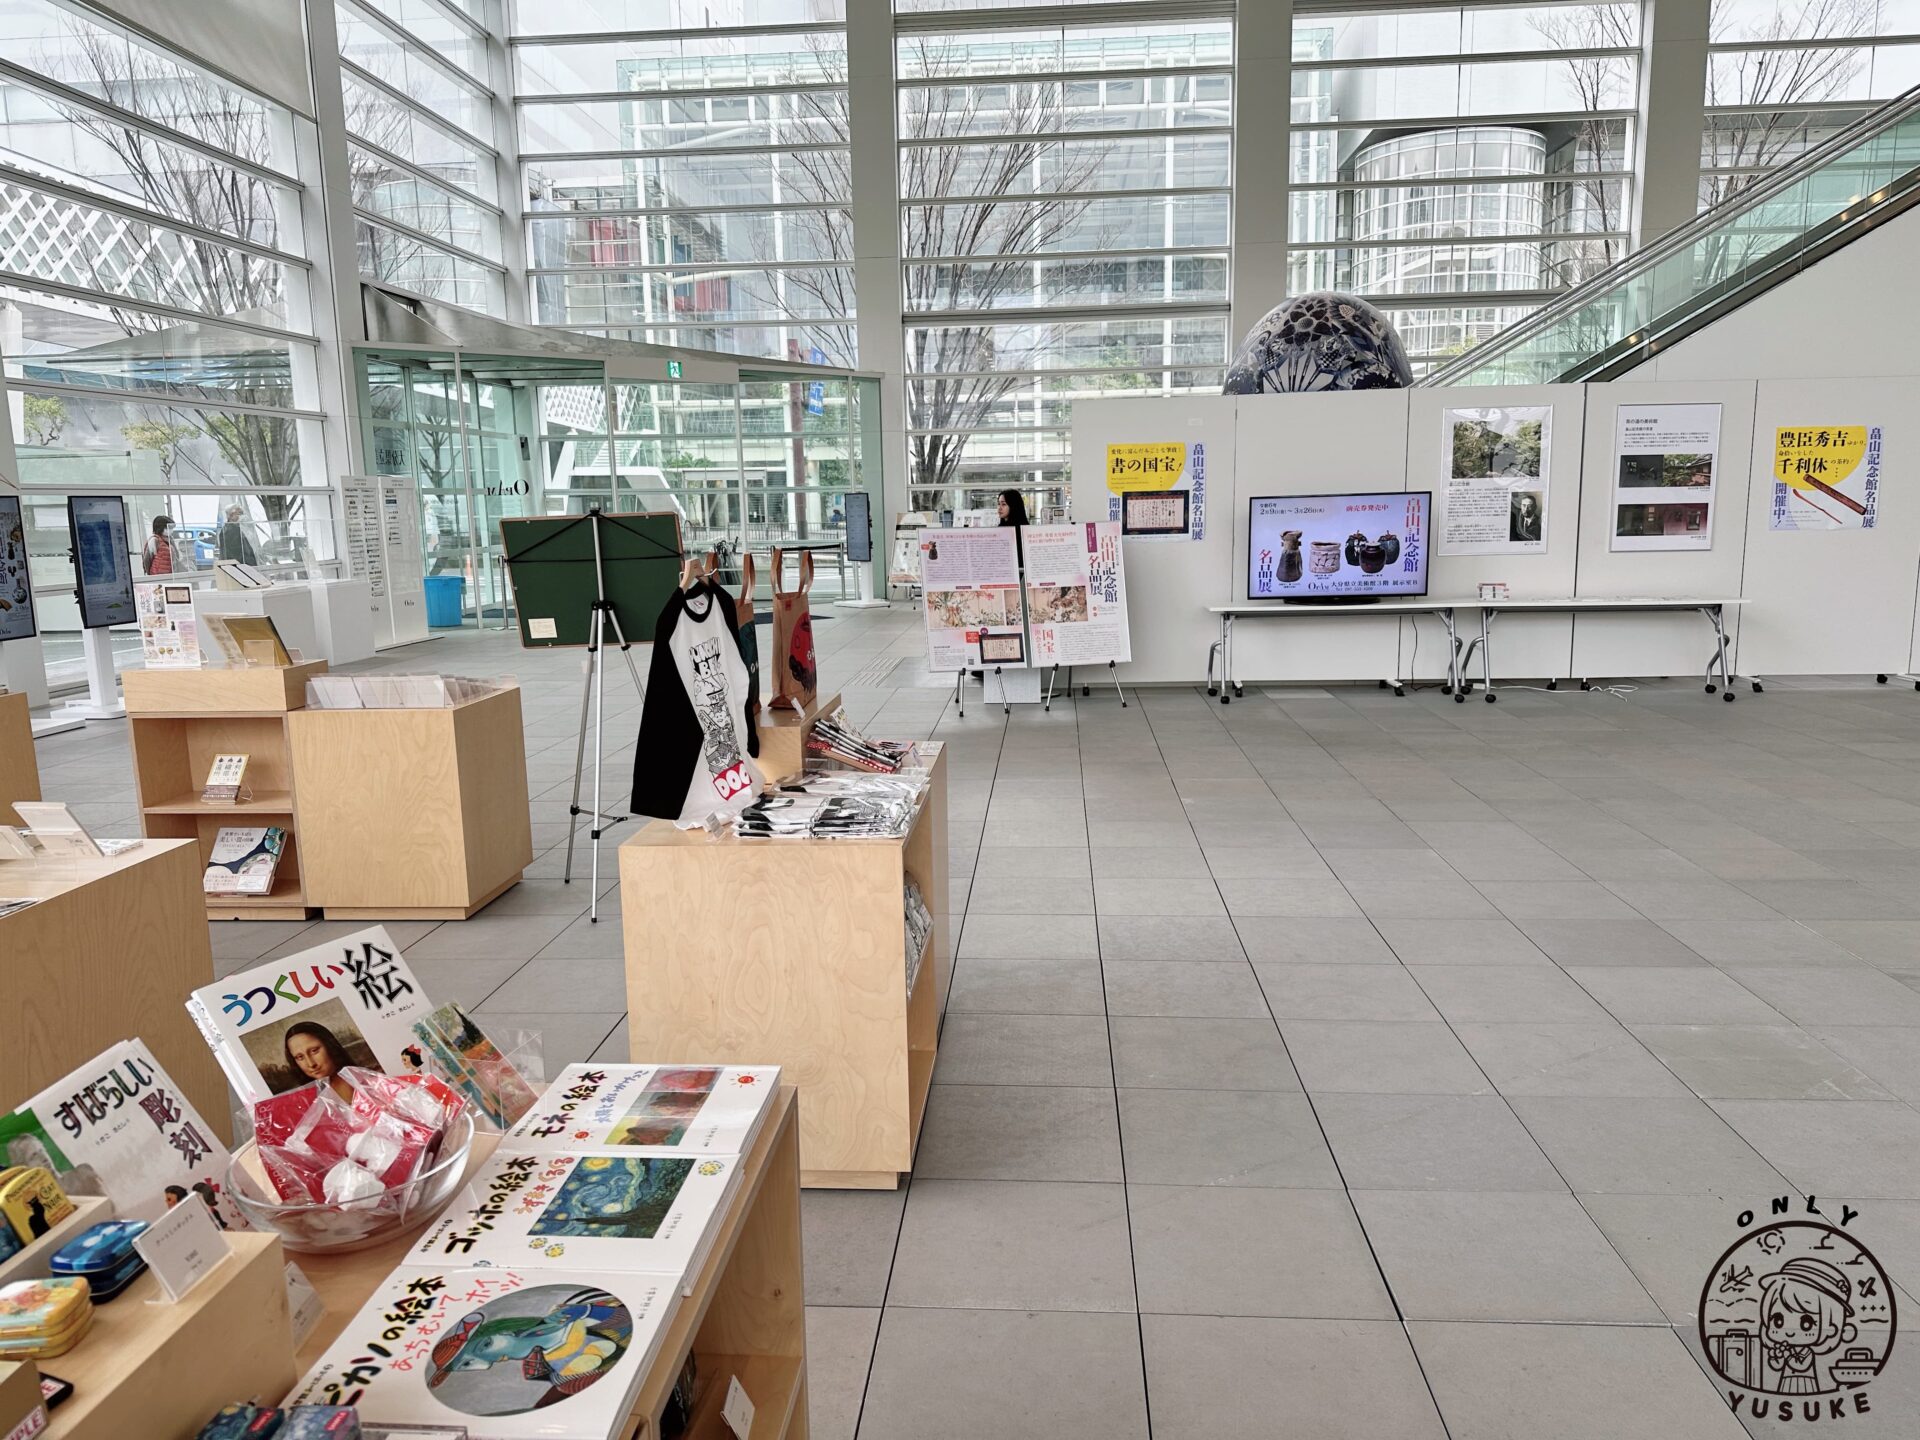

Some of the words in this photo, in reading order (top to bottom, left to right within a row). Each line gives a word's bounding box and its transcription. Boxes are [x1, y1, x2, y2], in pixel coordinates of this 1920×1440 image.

[1191, 443, 1205, 541] 畠山記念館名品展
[1861, 427, 1882, 529] 畠山記念館名品展
[1087, 555, 1104, 596] 名品展
[1100, 535, 1119, 603] 畠山記念館
[1258, 548, 1273, 594] 名品展
[1403, 497, 1421, 573] 畠山記念館
[53, 1057, 155, 1140] すばらしい
[138, 1088, 214, 1170] 彫刻
[531, 1070, 608, 1138] モネの絵本
[444, 1156, 540, 1255] ゴッホの絵本
[323, 1275, 447, 1407] ピカソの絵本
